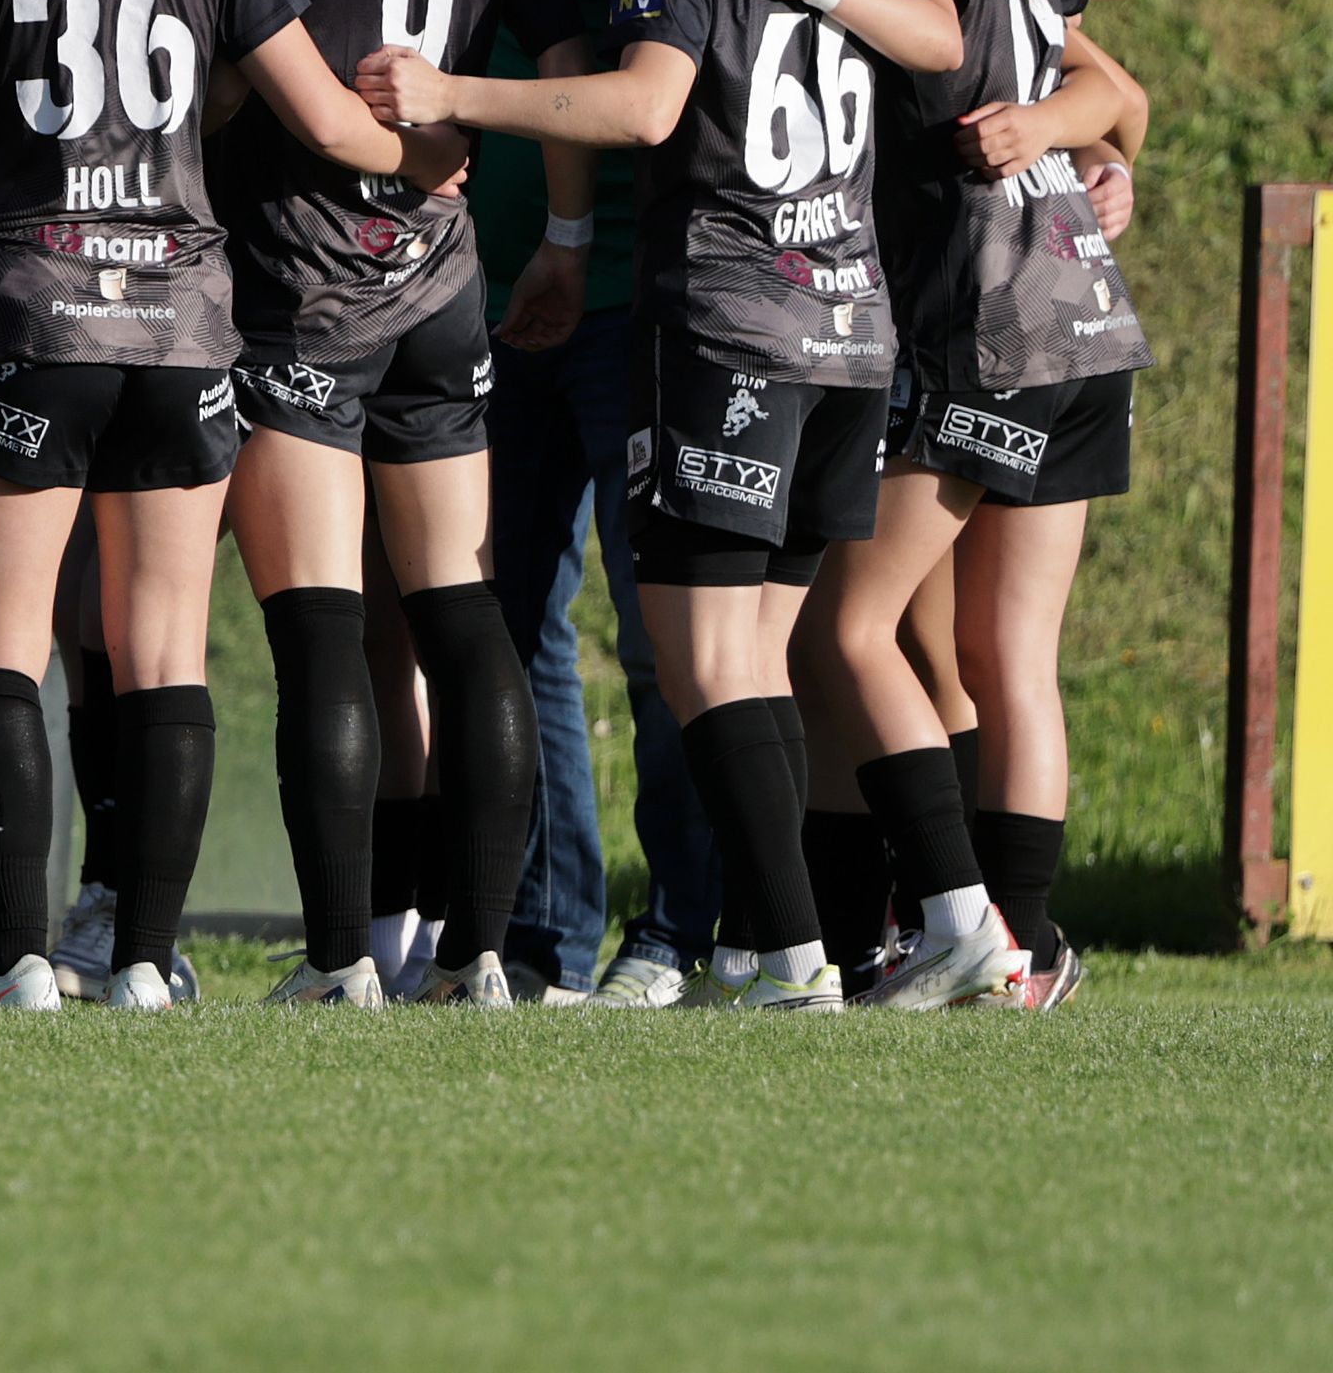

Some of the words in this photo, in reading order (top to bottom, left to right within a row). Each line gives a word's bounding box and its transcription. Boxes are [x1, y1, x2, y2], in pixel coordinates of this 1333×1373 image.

[744, 12, 872, 195] 66
[66, 162, 162, 211] HOLL
[773, 191, 863, 244] GRAFL
[51, 300, 176, 320] PapierService
[936, 433, 1037, 476] NATURCOSMETIC
[947, 411, 1043, 459] STYX
[674, 478, 774, 510] NATURCOSMETIC
[681, 452, 776, 493] STYX
